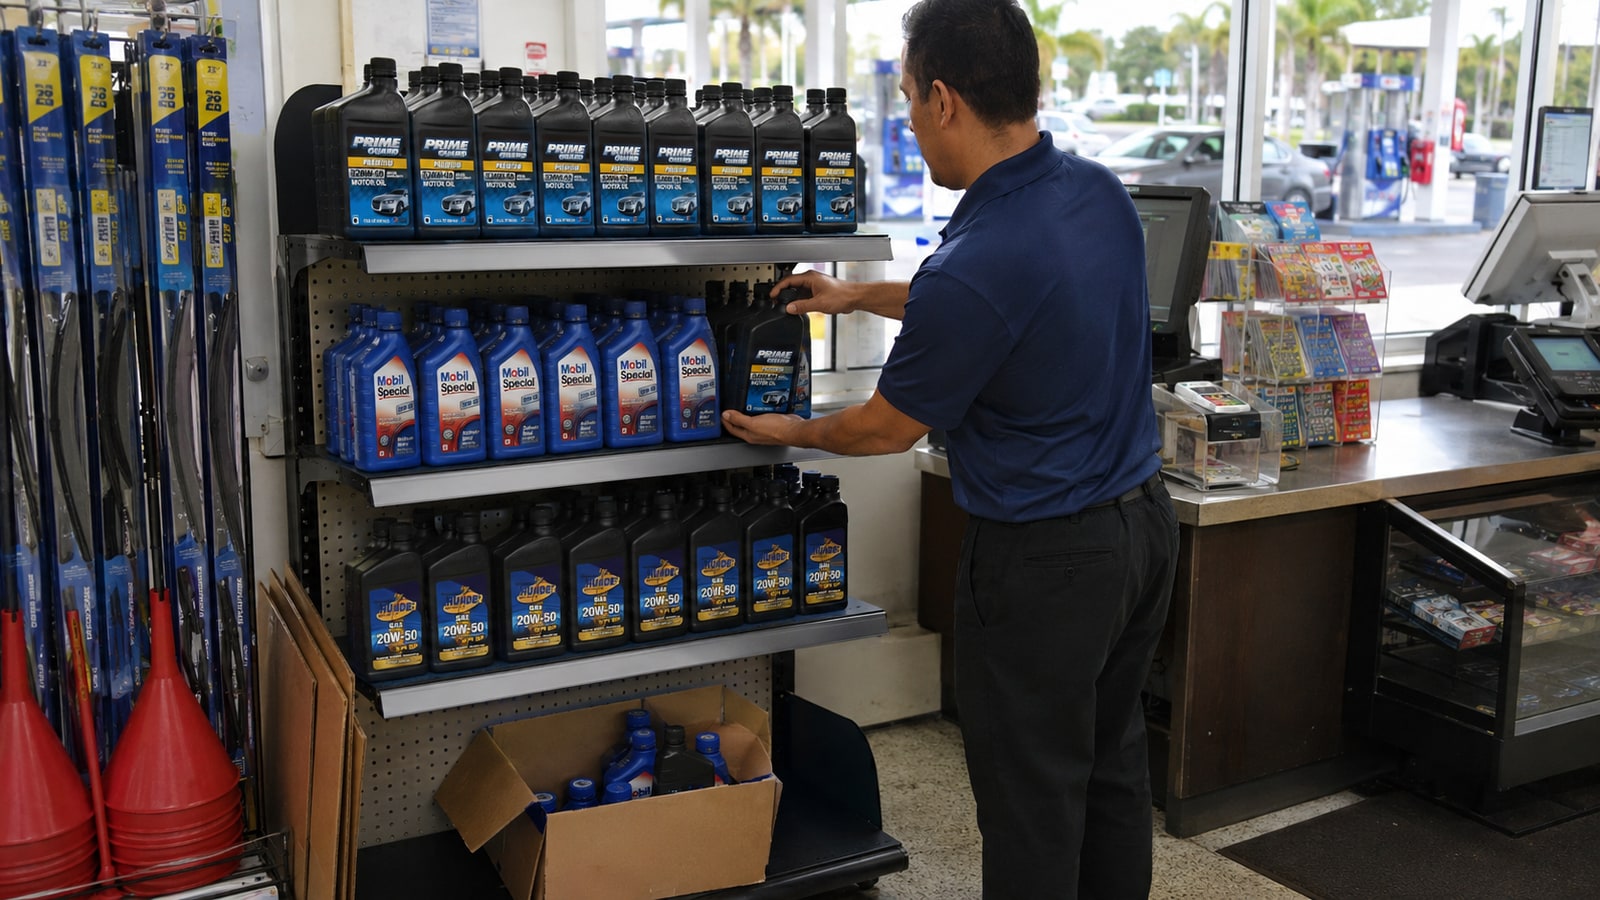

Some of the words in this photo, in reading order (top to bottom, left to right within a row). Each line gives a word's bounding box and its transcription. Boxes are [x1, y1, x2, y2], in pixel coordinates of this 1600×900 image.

[352, 136, 401, 148] PRIME
[424, 139, 469, 150] PRIME
[486, 141, 528, 152] PRIME
[546, 144, 586, 154] PRIME
[603, 146, 641, 156] PRIME
[657, 147, 694, 157] PRIME
[714, 149, 750, 159] PRIME
[764, 150, 800, 160] PRIME
[818, 152, 852, 161] PRIME
[681, 354, 706, 366] Mobil
[756, 350, 793, 359] PRIME
[561, 363, 586, 374] Mobil
[620, 359, 647, 370] Mobil
[440, 370, 469, 382] Mobil
[502, 366, 529, 378] Mobil
[620, 369, 653, 381] Special
[682, 365, 712, 377] Special
[377, 374, 404, 386] Mobil
[503, 378, 535, 390] Special
[561, 374, 592, 386] Special
[378, 386, 410, 398] Special
[441, 381, 476, 394] Special
[756, 576, 790, 590] 20W-50
[701, 584, 736, 598] 20W-50
[644, 594, 680, 609] 20W-50
[582, 604, 620, 617] 20W-50
[517, 612, 557, 626] 20W-50
[443, 622, 484, 637] 20W-50
[376, 630, 417, 644] 20W-50
